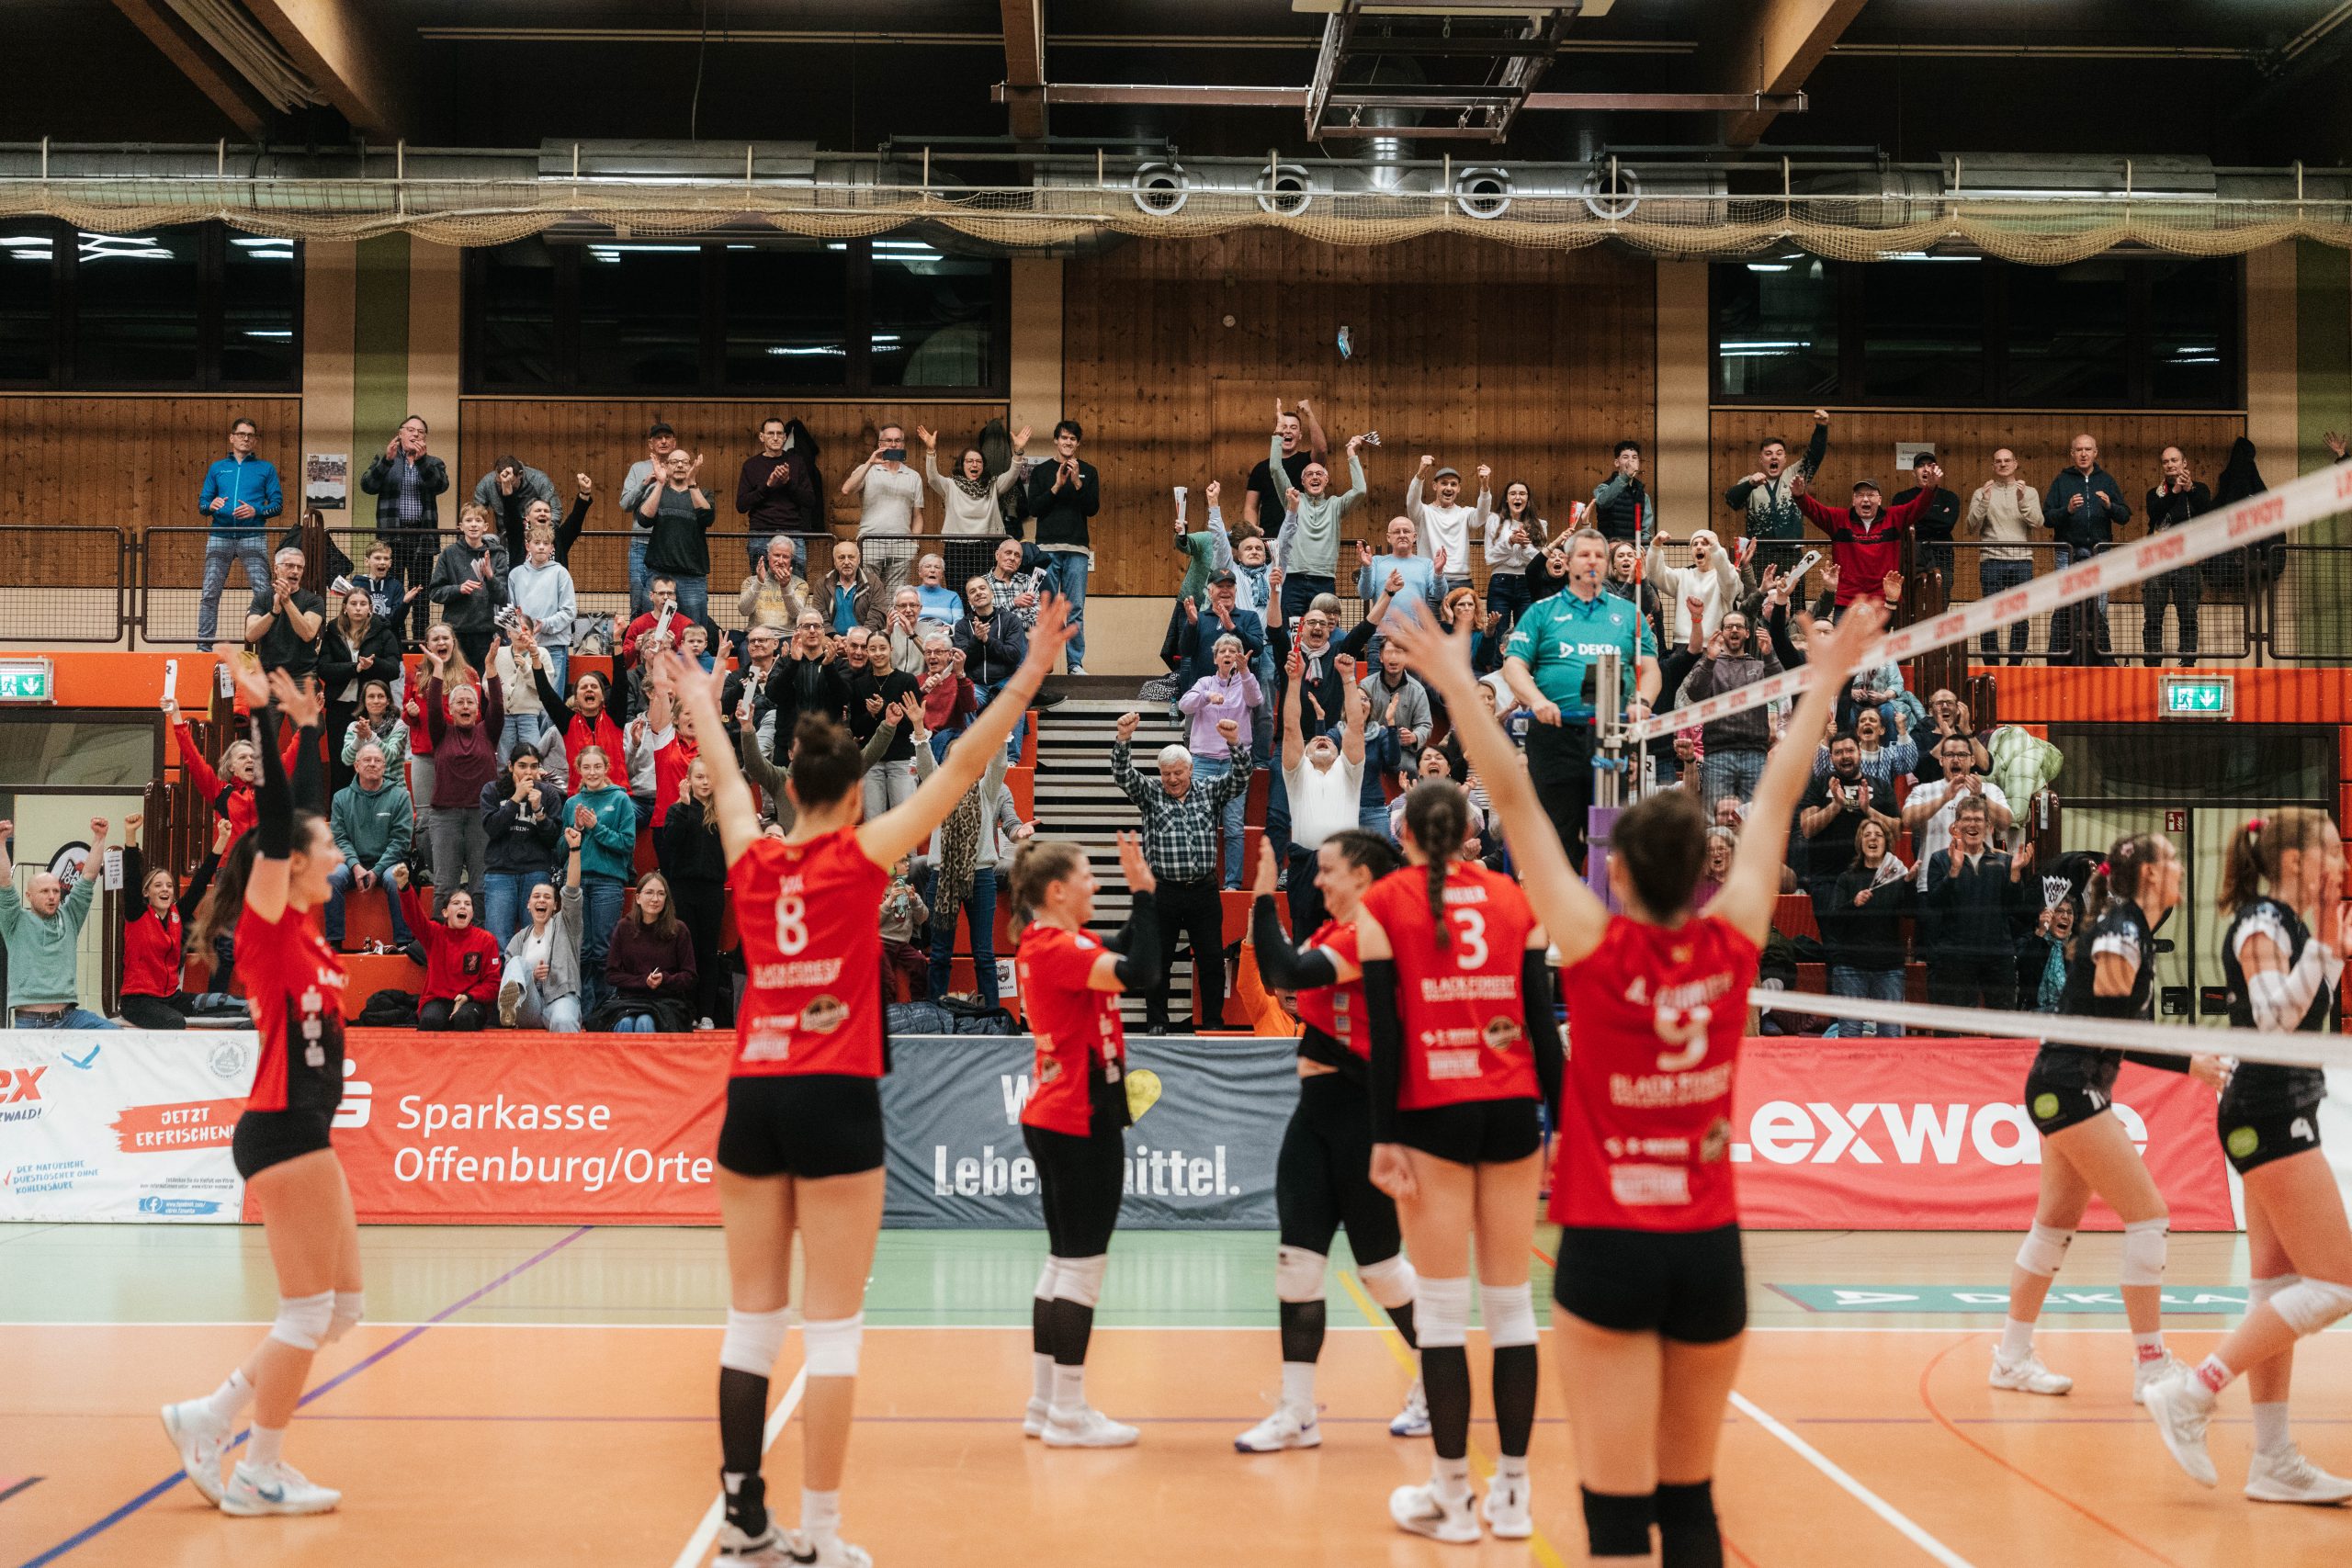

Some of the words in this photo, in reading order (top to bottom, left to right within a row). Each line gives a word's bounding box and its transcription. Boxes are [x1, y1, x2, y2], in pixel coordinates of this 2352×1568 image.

[1577, 643, 1622, 656] DEKRA
[775, 895, 808, 956] 8
[1453, 908, 1488, 970] 3
[161, 1107, 209, 1124] JETZT
[396, 1094, 611, 1138] Sparkasse
[136, 1124, 234, 1146] ERFRISCHEN!
[17, 1165, 32, 1174] DER
[77, 1168, 98, 1178] OHNE
[935, 1145, 1240, 1196] Lebeittel.
